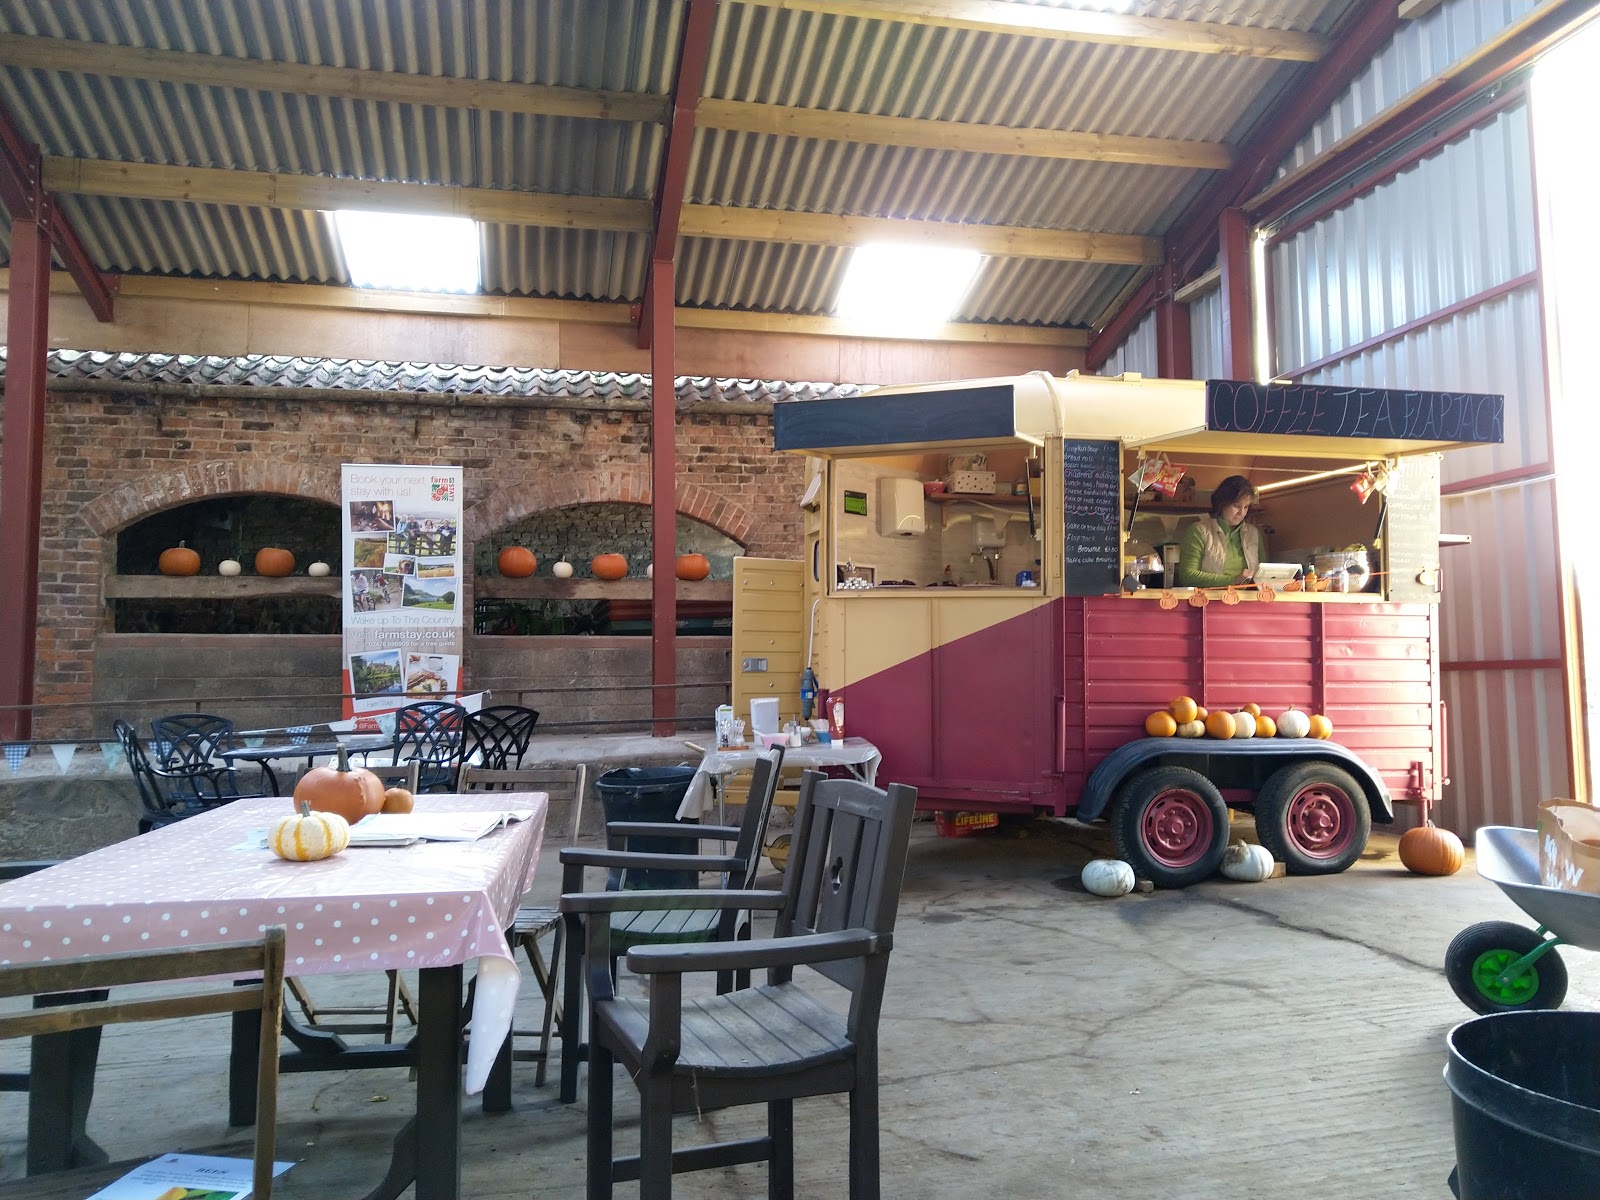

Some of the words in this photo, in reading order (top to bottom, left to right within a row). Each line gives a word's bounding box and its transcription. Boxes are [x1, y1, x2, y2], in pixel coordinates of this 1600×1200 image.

[1213, 382, 1328, 434] COFFEE
[1333, 387, 1395, 438] TEA
[1400, 392, 1504, 441] FLAPJACK
[350, 474, 376, 485] Book
[379, 476, 401, 487] your
[403, 476, 425, 485] next
[350, 487, 372, 497] stay
[374, 487, 393, 497] with
[397, 488, 411, 497] us!
[351, 616, 374, 625] Wake
[379, 618, 389, 626] up
[391, 616, 400, 624] To
[403, 616, 420, 624] The
[421, 615, 456, 626] Country
[351, 631, 370, 640] Visit
[374, 629, 455, 640] farmstay.co.uk
[955, 813, 994, 826] LIFELINE
